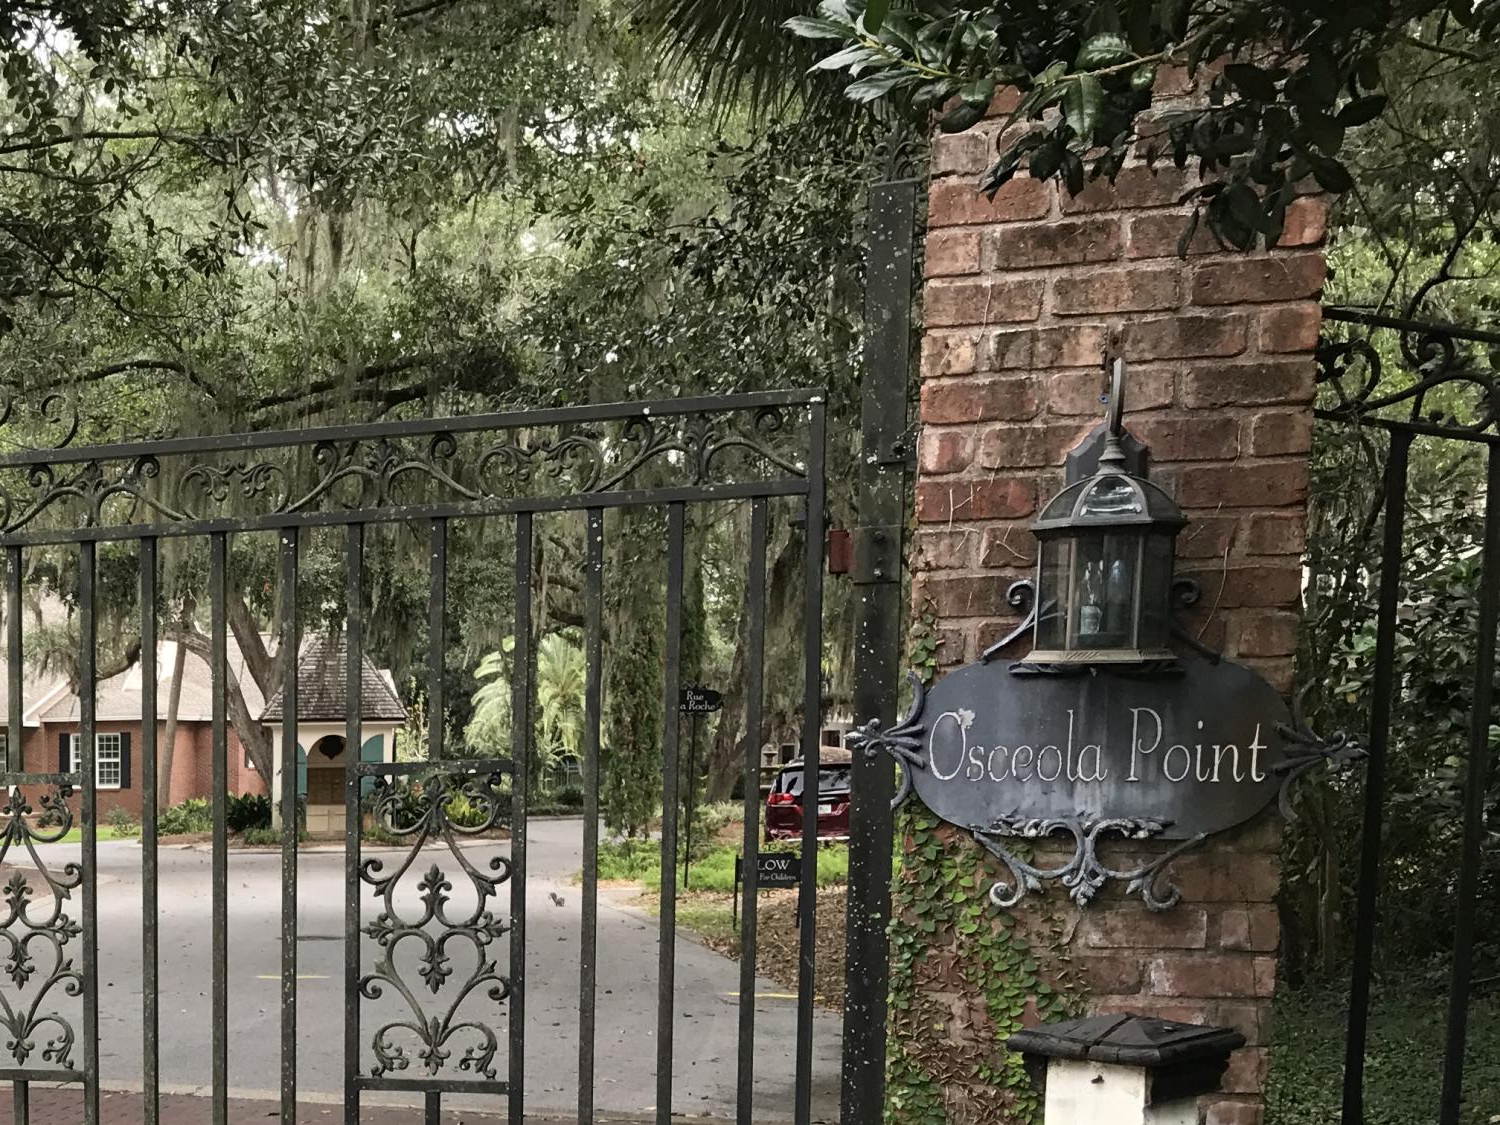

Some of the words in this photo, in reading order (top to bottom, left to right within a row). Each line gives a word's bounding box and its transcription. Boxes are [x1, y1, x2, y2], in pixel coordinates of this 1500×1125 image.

[686, 690, 704, 700] Rue
[688, 701, 715, 711] Roche
[929, 708, 1108, 782] Osceola
[1126, 707, 1267, 783] Point
[757, 859, 791, 871] LOW
